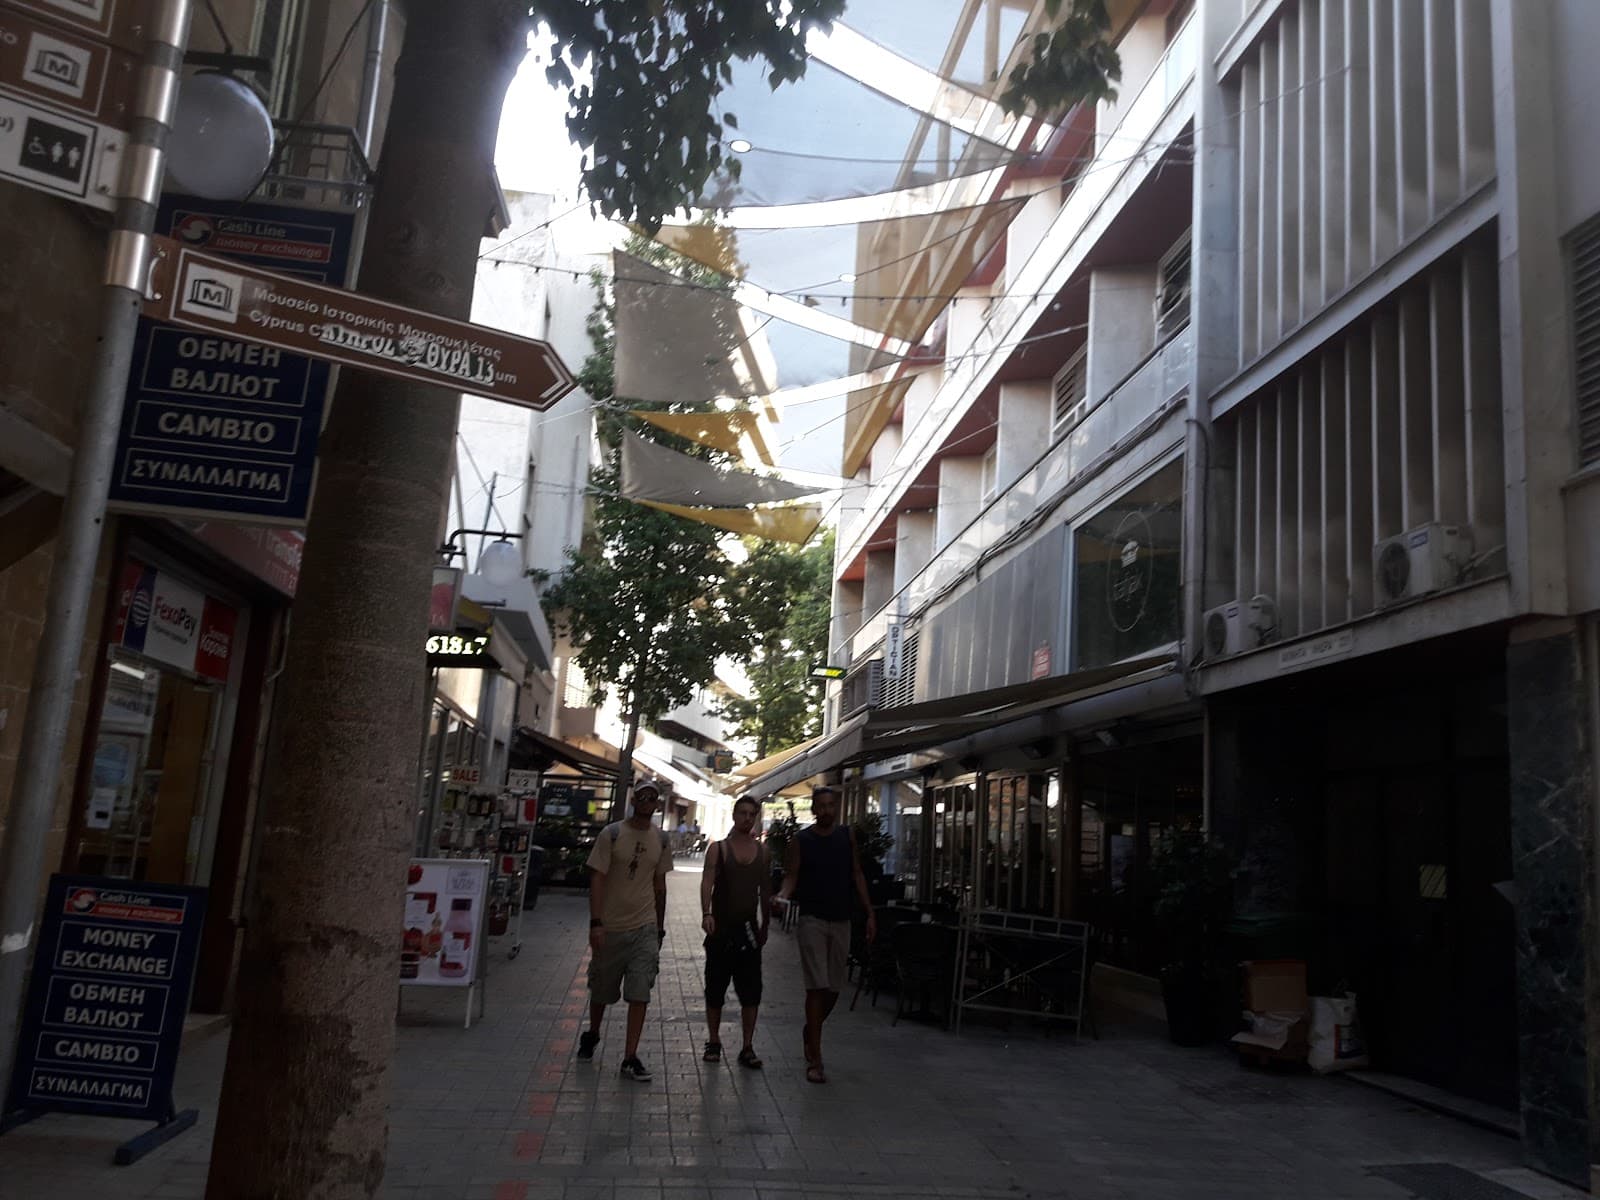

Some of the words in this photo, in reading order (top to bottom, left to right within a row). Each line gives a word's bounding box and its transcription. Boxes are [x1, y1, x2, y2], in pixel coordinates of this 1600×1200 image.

[216, 219, 252, 234] Cash
[255, 223, 288, 239] Line
[215, 238, 258, 252] money
[262, 243, 323, 259] exchange
[249, 309, 305, 333] Cyprus
[253, 287, 319, 313] Μουσείο
[323, 303, 394, 334] Ιστορικής
[177, 336, 282, 368] ОБМЕН
[169, 367, 281, 399] ВАЛЮТ
[157, 411, 277, 444] CAMBIO
[130, 458, 282, 492] ΣΥΝΑΛΛΑΓΜΑ
[888, 626, 900, 677] OPTICIAN
[452, 768, 480, 783] SALE
[82, 927, 157, 949] MONEY
[60, 950, 169, 975] EXCHANGE
[69, 982, 146, 1004] ОБМЕН
[63, 1006, 145, 1029] ВАЛЮТ
[54, 1039, 140, 1064] CAMBIO
[33, 1075, 144, 1100] ΣΥΝΑΛΛΑΓΜΑ
